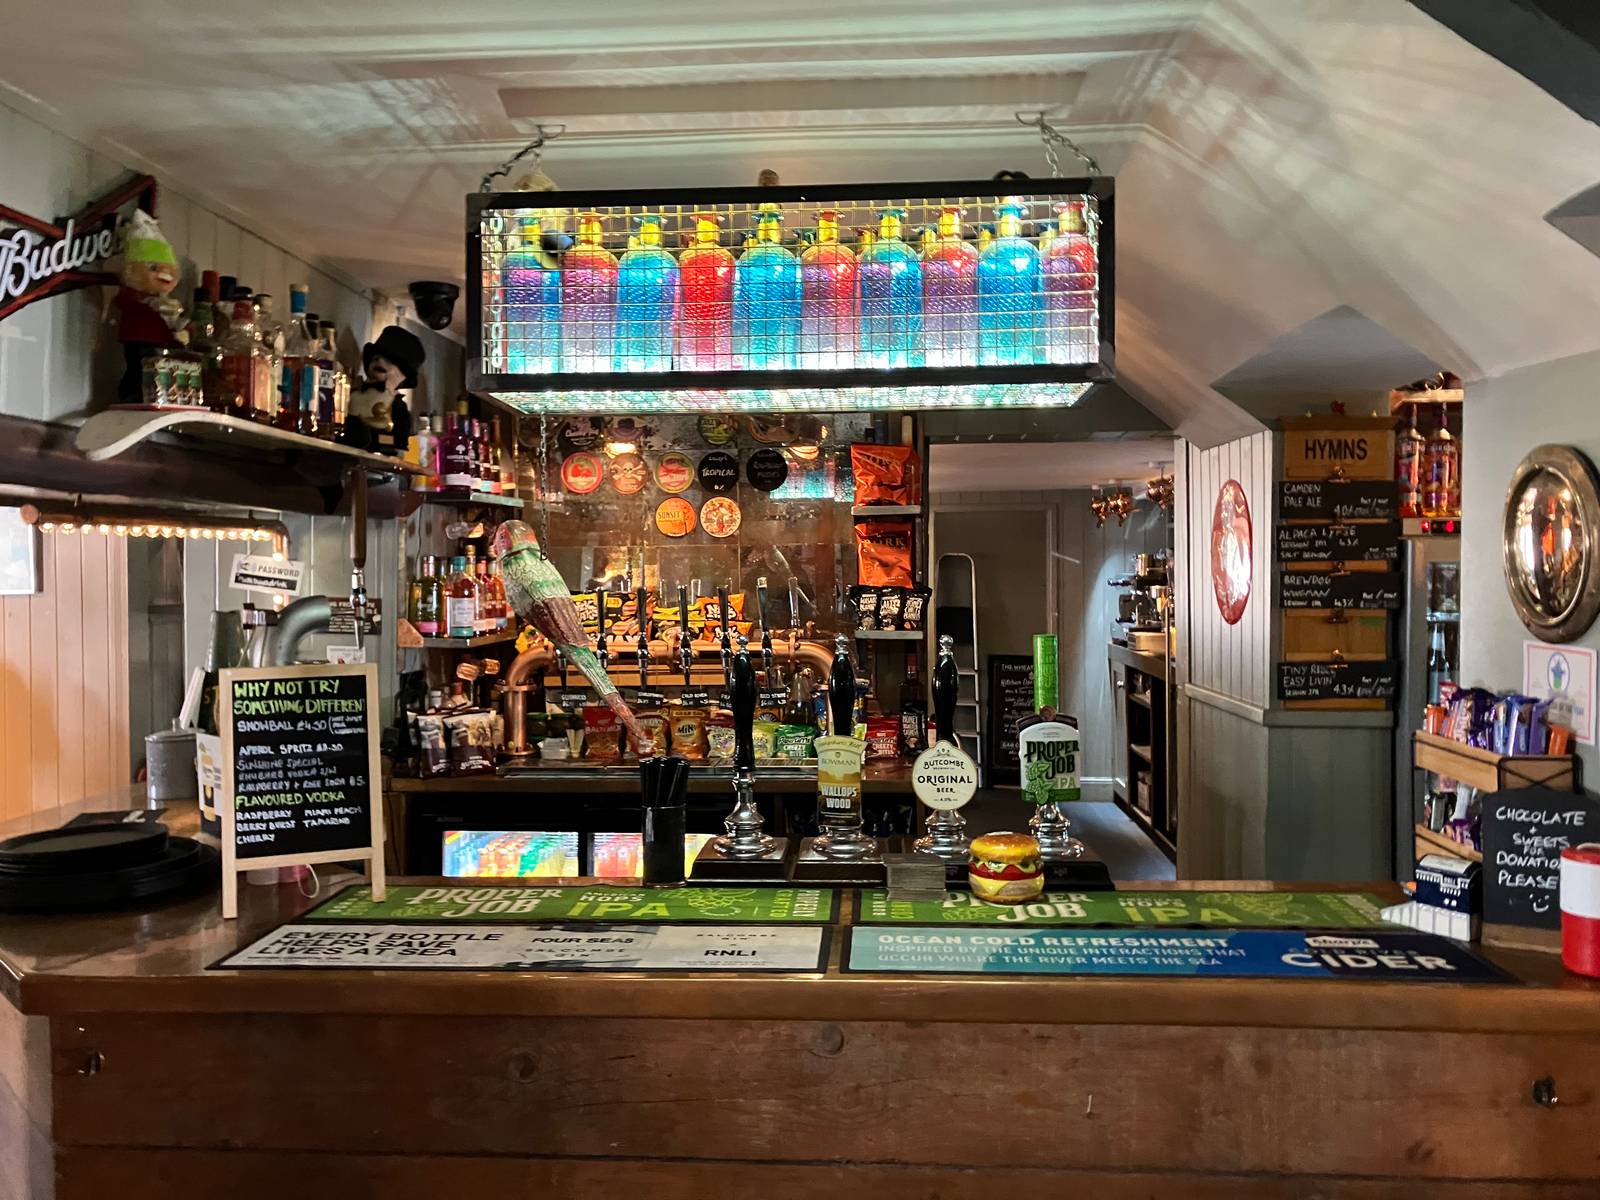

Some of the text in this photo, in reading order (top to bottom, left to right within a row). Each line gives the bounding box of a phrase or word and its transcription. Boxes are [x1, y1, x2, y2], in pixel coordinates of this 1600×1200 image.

[1304, 438, 1368, 461] HYMNS
[701, 467, 736, 478] TROPICAL
[1283, 482, 1321, 494] CAMDEN
[1306, 495, 1322, 508] ALE
[657, 510, 681, 520] SUNSET
[257, 564, 301, 578] PASSWORD
[1284, 575, 1331, 585] BREWDOG
[1281, 665, 1307, 676] TINY
[1283, 676, 1306, 688] EASY
[234, 679, 340, 698] WHY NOT TRY
[233, 700, 304, 716] SOMETHING
[237, 719, 294, 732] SNOWBALL
[280, 743, 313, 755] SPRITZ
[1024, 740, 1080, 763] PROPER
[821, 758, 856, 766] BOWMAN
[923, 759, 965, 770] BUTCOMBE
[1045, 755, 1075, 780] JOB
[917, 775, 973, 786] ORIGINAL
[1055, 777, 1076, 788] IPA
[821, 786, 857, 797] WALLOPS
[236, 791, 346, 810] FLAVOURED VODKA
[826, 797, 851, 809] WOOD
[236, 809, 292, 821] RASPBERRY
[1496, 806, 1586, 826] CHOCOLATE
[236, 834, 275, 845] CHERRY
[1512, 832, 1571, 850] SWEETS
[1523, 845, 1544, 856] FOR
[1498, 869, 1560, 889] PLEASE
[403, 888, 564, 905] PROPER
[440, 900, 543, 917] JOB
[566, 902, 670, 917] IPA
[996, 902, 1088, 922] JOB
[1123, 907, 1242, 922] IPA
[281, 931, 505, 941] EVERY BOTTLE
[879, 935, 1230, 947] OCEAN COLD REFRESHMENT
[268, 939, 457, 949] HELPS SAVE
[256, 946, 346, 955] LIVES
[397, 948, 458, 956] SEA
[703, 949, 757, 957] RNLI
[878, 945, 1246, 957] INSPIRED BY THE UNIQUE INTERACTIONS THAT
[877, 954, 933, 962] OCCUR
[938, 955, 996, 963] WHERE
[1037, 956, 1089, 964] RIVER
[1092, 956, 1150, 964] MEETS
[1152, 957, 1185, 965] THE
[1188, 957, 1222, 965] SEA
[1281, 953, 1457, 970] CIDER
